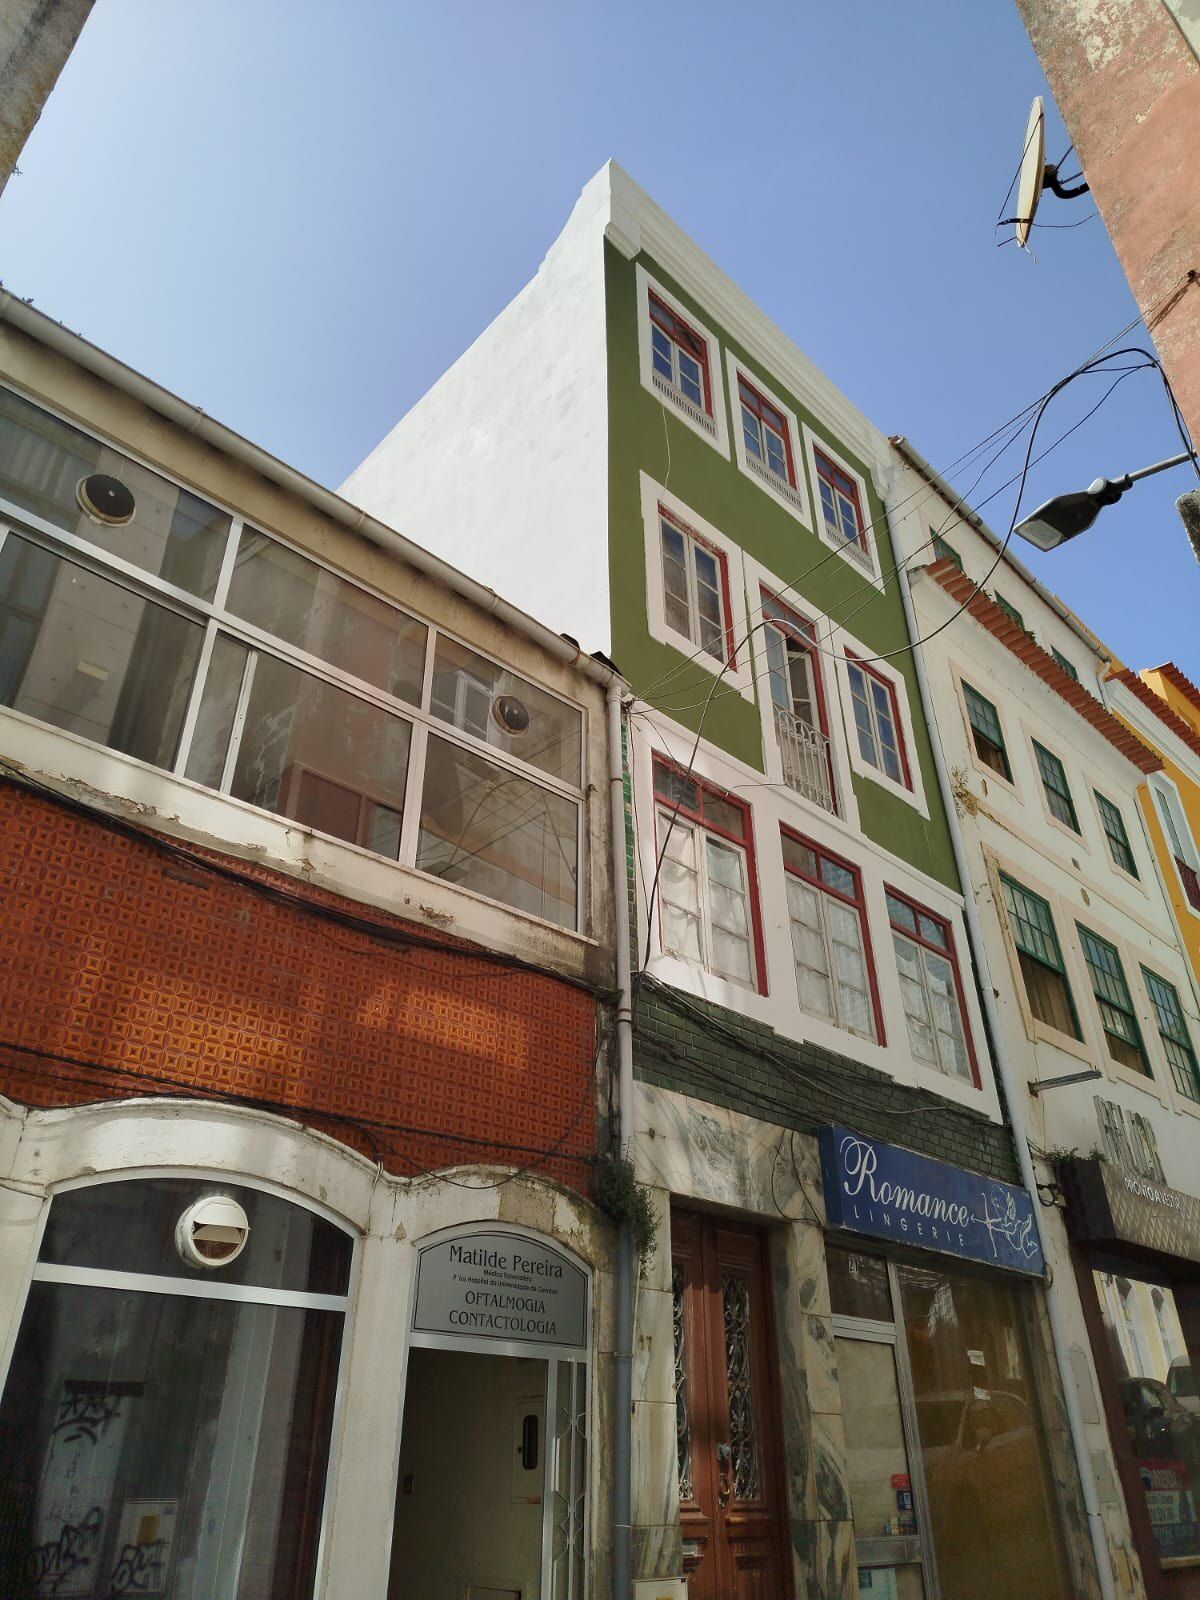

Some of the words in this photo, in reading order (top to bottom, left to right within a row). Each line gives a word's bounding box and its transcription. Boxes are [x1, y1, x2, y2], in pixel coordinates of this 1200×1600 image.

[840, 1136, 970, 1228] Romance
[854, 1204, 966, 1247] LINGERIE
[449, 1245, 507, 1270] Matilde
[513, 1255, 563, 1279] Pereira
[465, 1290, 546, 1314] OFTALMOGIA
[449, 1310, 557, 1336] CONTACTOLOGIA
